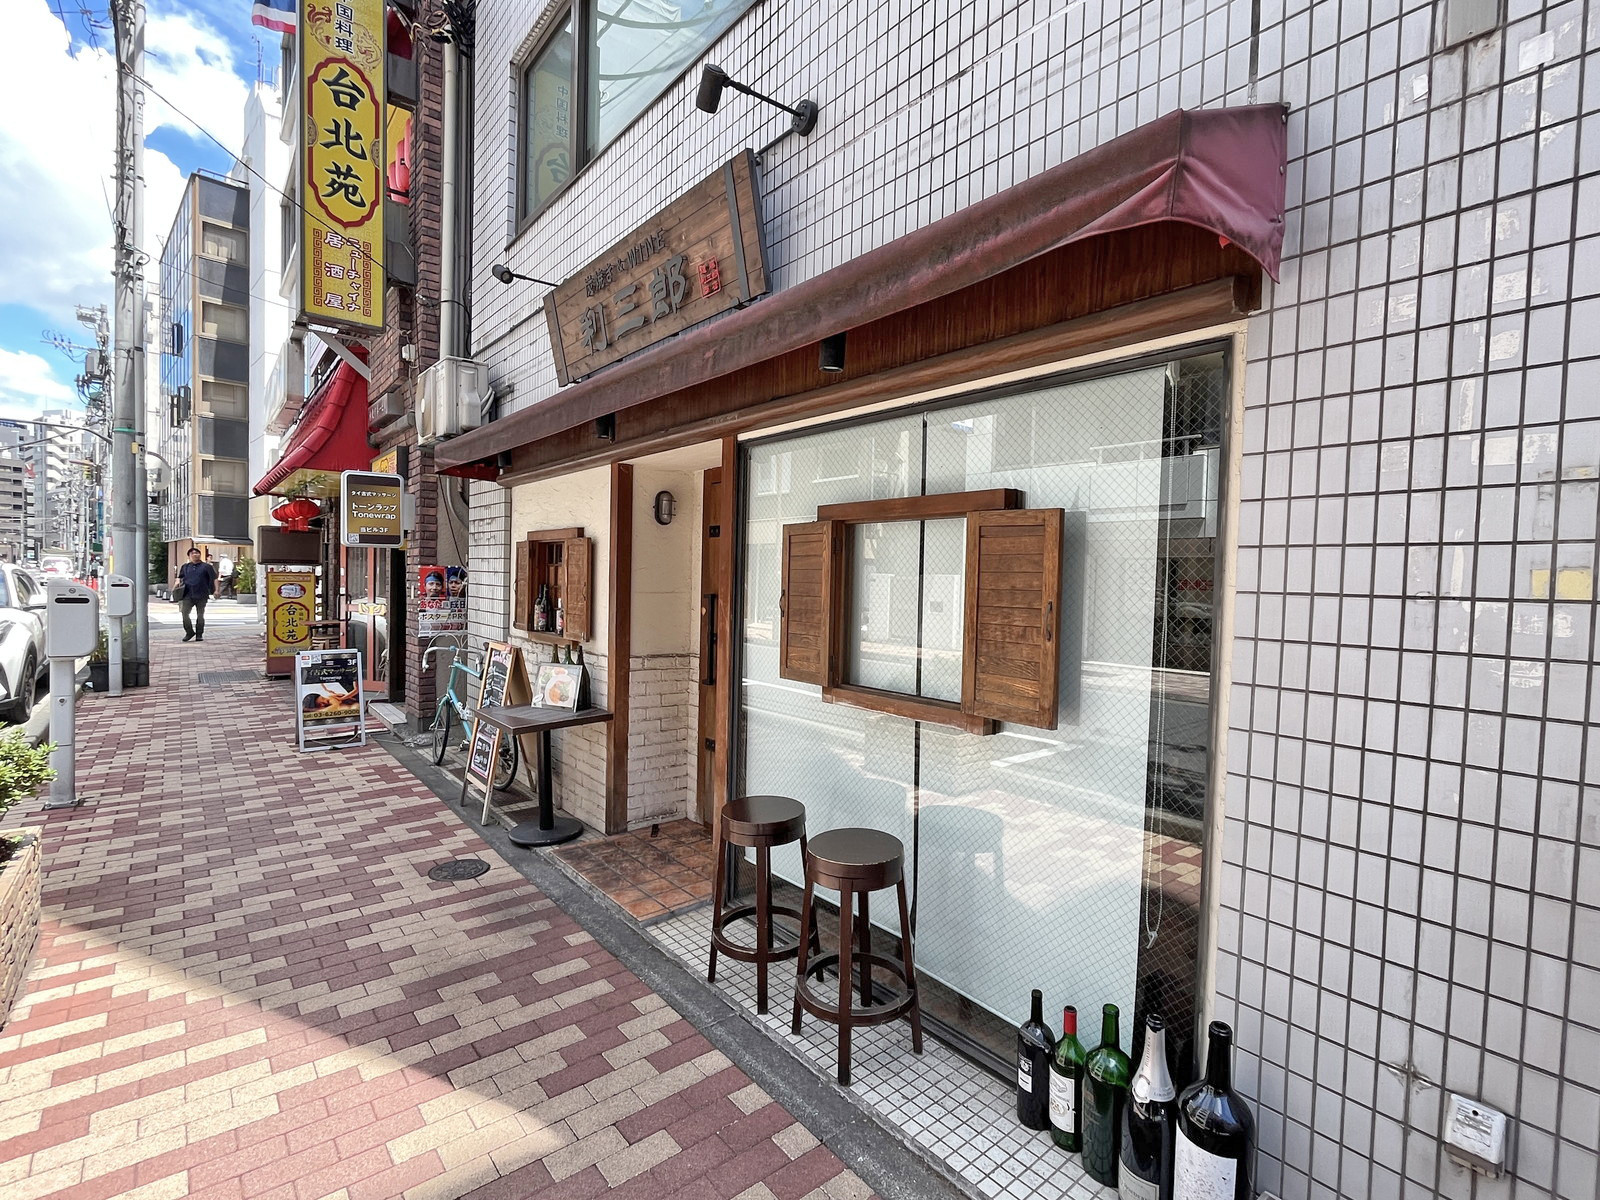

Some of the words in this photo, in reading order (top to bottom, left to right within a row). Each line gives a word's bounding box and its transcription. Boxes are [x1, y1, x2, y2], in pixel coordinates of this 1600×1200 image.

[335, 0, 354, 54] 国料理
[319, 66, 367, 208] 台北苑
[324, 231, 345, 310] 居酒屋
[346, 237, 362, 312] ニューチャイナ
[626, 227, 666, 269] WINE
[580, 254, 688, 356] 利三郎
[352, 502, 397, 512] トーンラップ
[352, 510, 396, 520] Tonewrap
[285, 604, 298, 641] 台北苑
